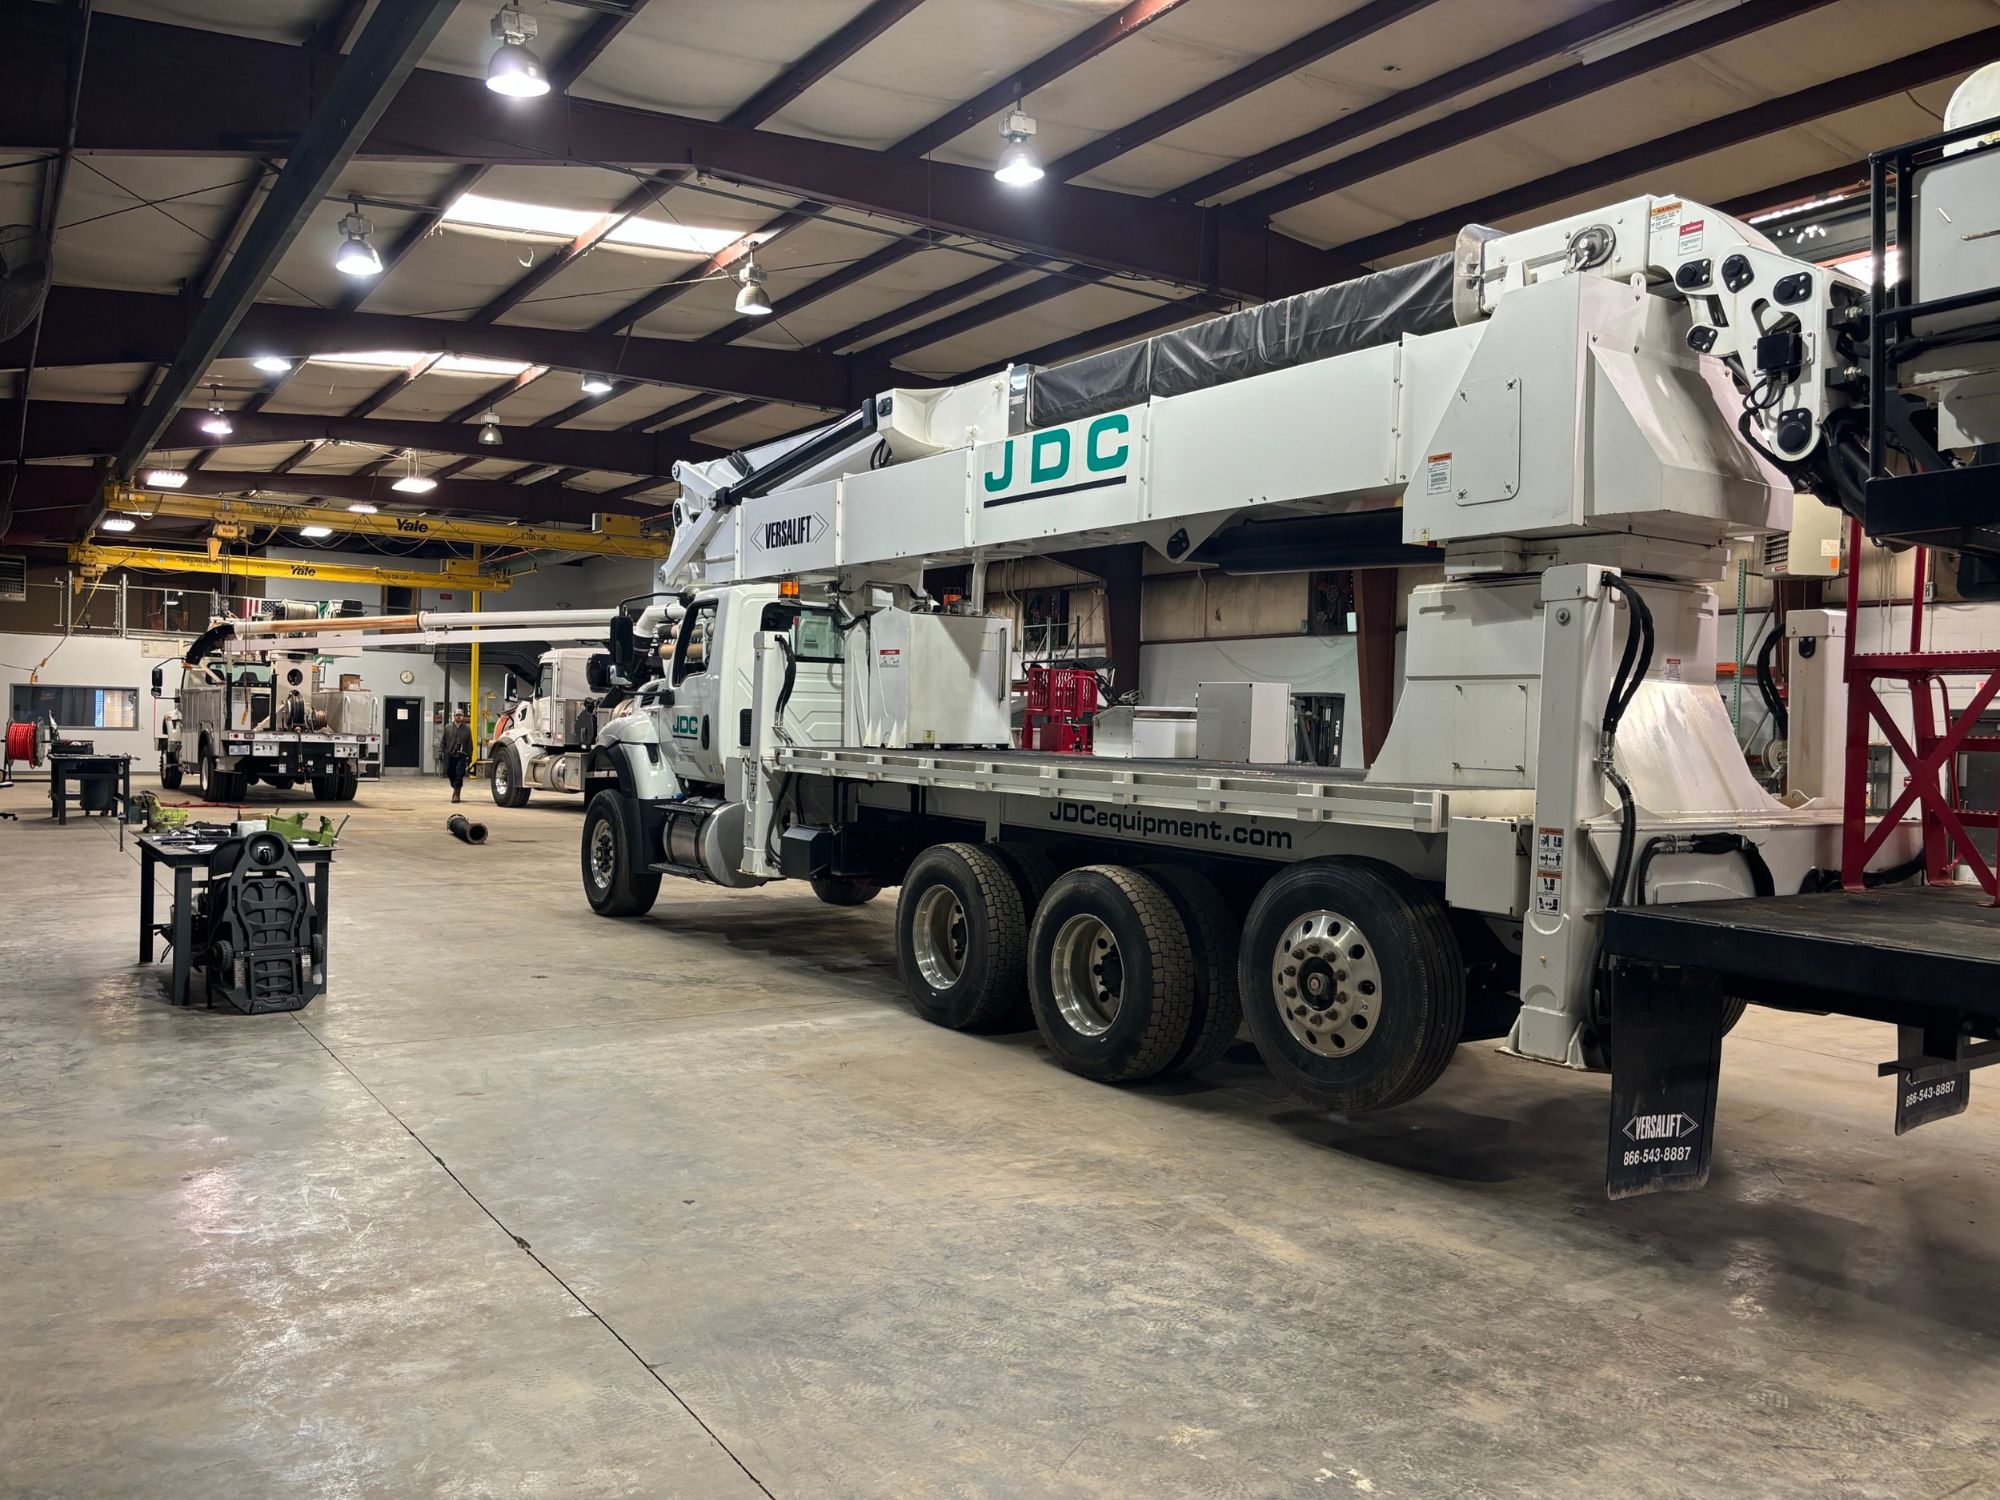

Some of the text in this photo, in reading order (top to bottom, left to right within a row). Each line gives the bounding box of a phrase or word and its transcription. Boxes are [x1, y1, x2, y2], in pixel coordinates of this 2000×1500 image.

[985, 414, 1129, 492] JDC
[396, 518, 429, 533] Yale
[765, 515, 811, 549] VERSALIFT
[290, 565, 316, 576] Yale
[672, 715, 698, 734] JDC
[1050, 802, 1292, 849] JDCequipment.com
[1905, 1080, 1956, 1107] 866-543-8887
[1635, 1114, 1682, 1140] VERSALIFT
